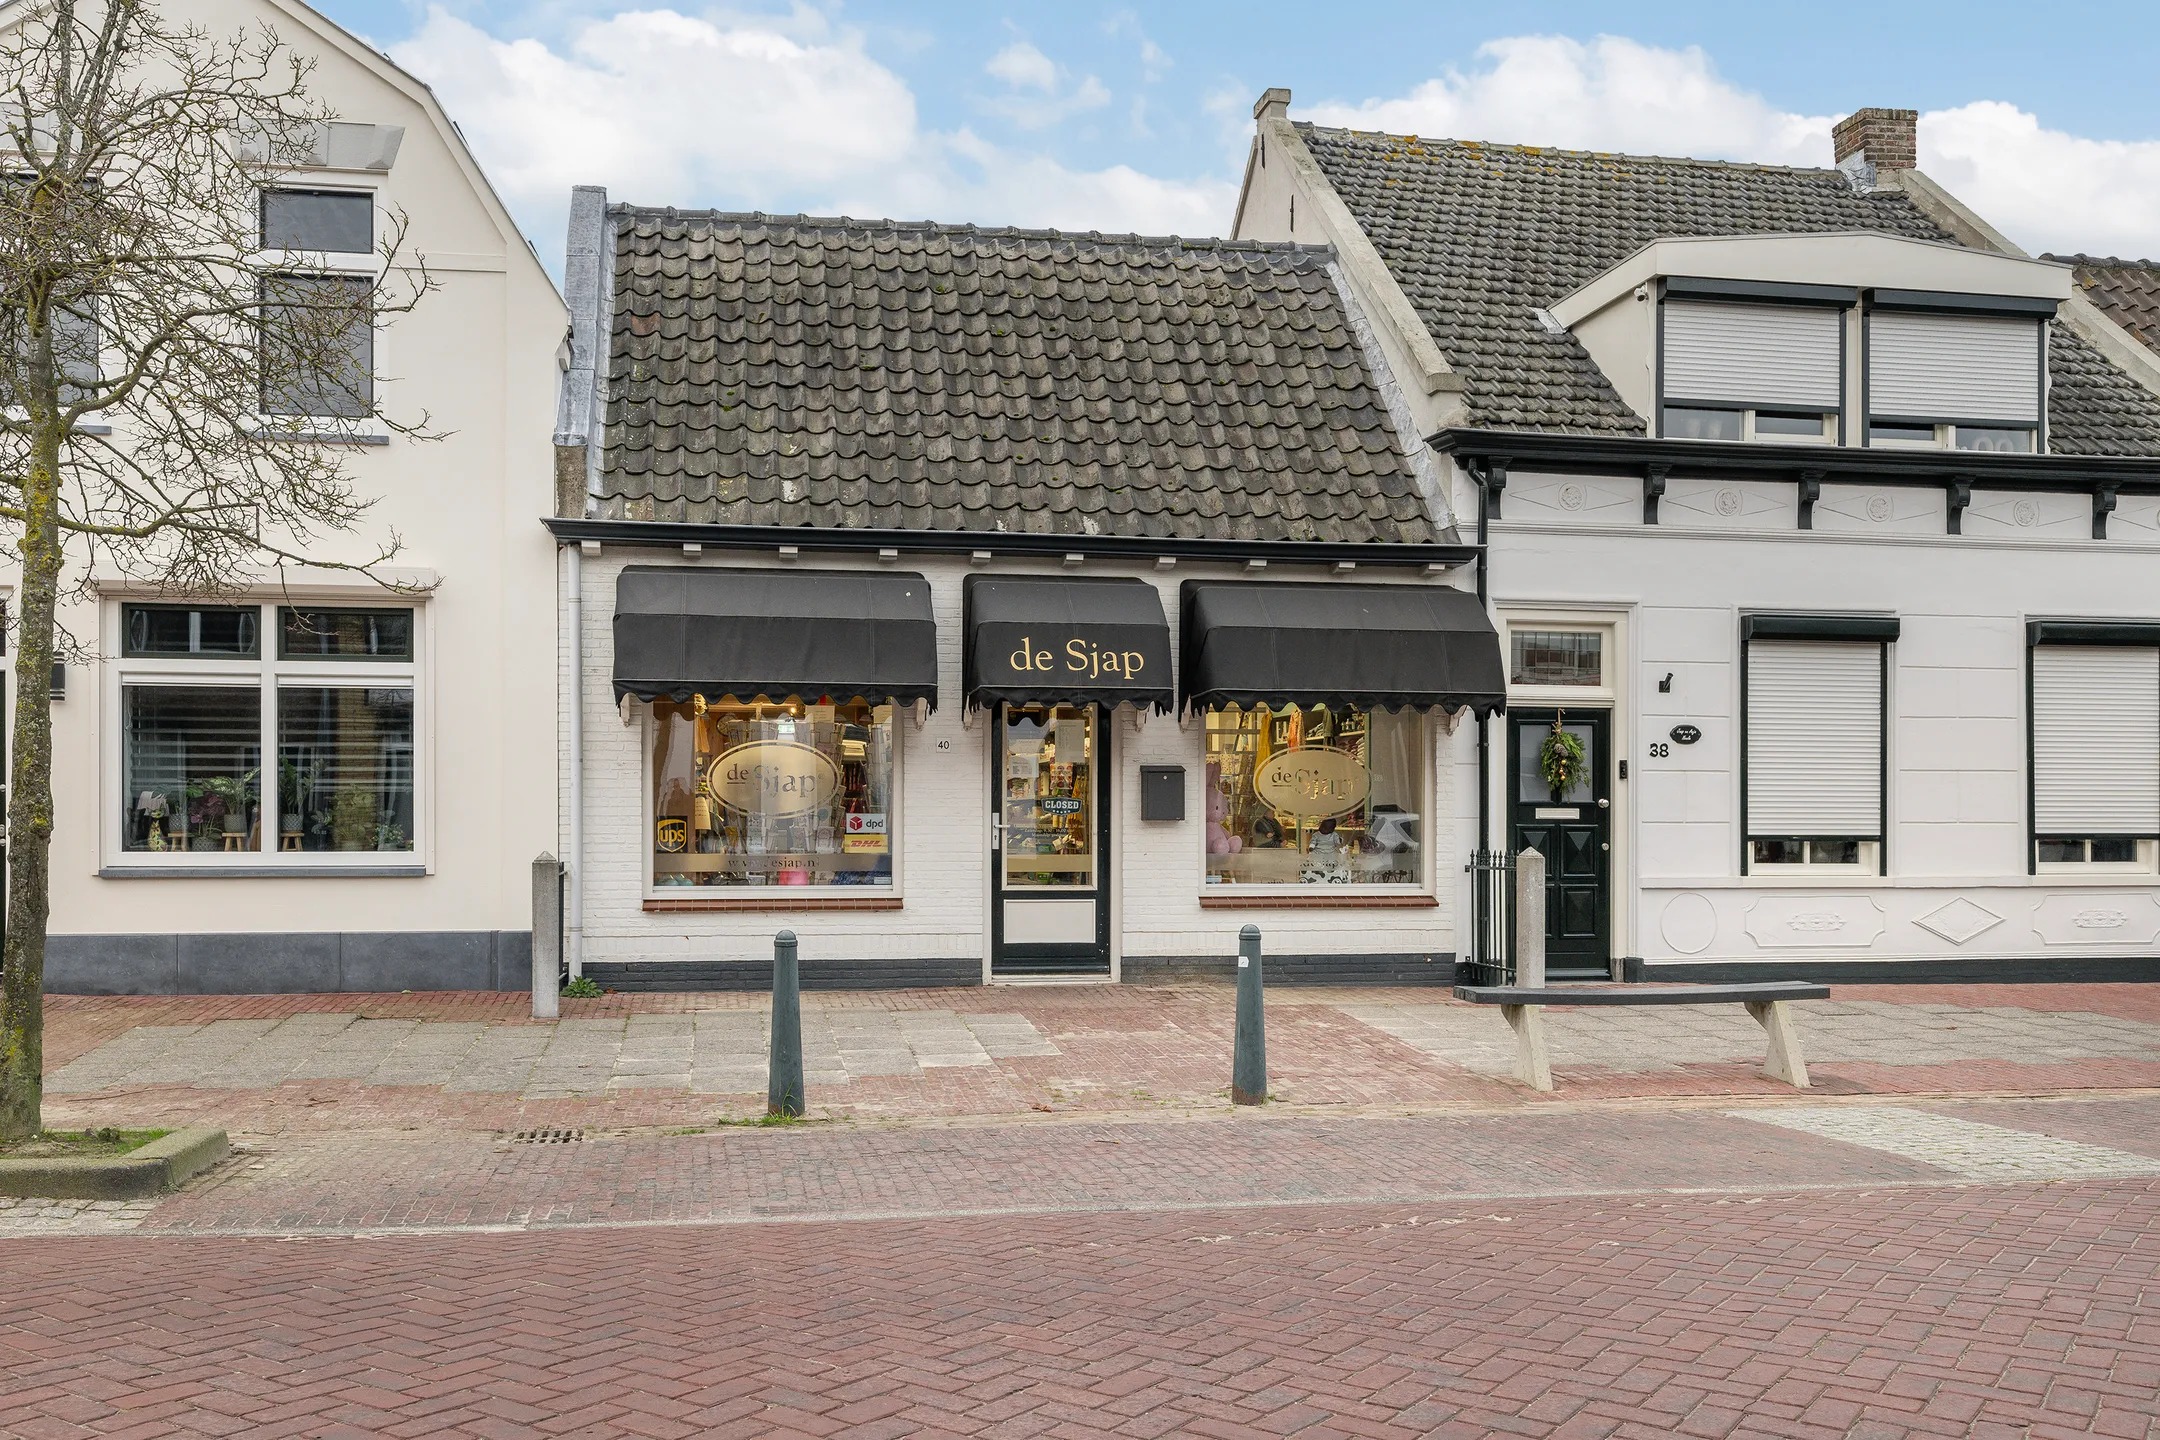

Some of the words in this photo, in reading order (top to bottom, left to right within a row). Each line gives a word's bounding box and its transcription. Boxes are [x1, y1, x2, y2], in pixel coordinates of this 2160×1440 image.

[1010, 636, 1054, 671] de
[1066, 638, 1145, 680] Sjap
[937, 740, 950, 750] 40
[1649, 742, 1669, 758] 38
[726, 763, 749, 781] de
[753, 765, 816, 798] Sjap
[1271, 766, 1292, 783] de
[1044, 800, 1079, 810] CLOSED
[865, 818, 884, 830] dpd
[659, 829, 685, 847] ups
[851, 840, 882, 848] DHL
